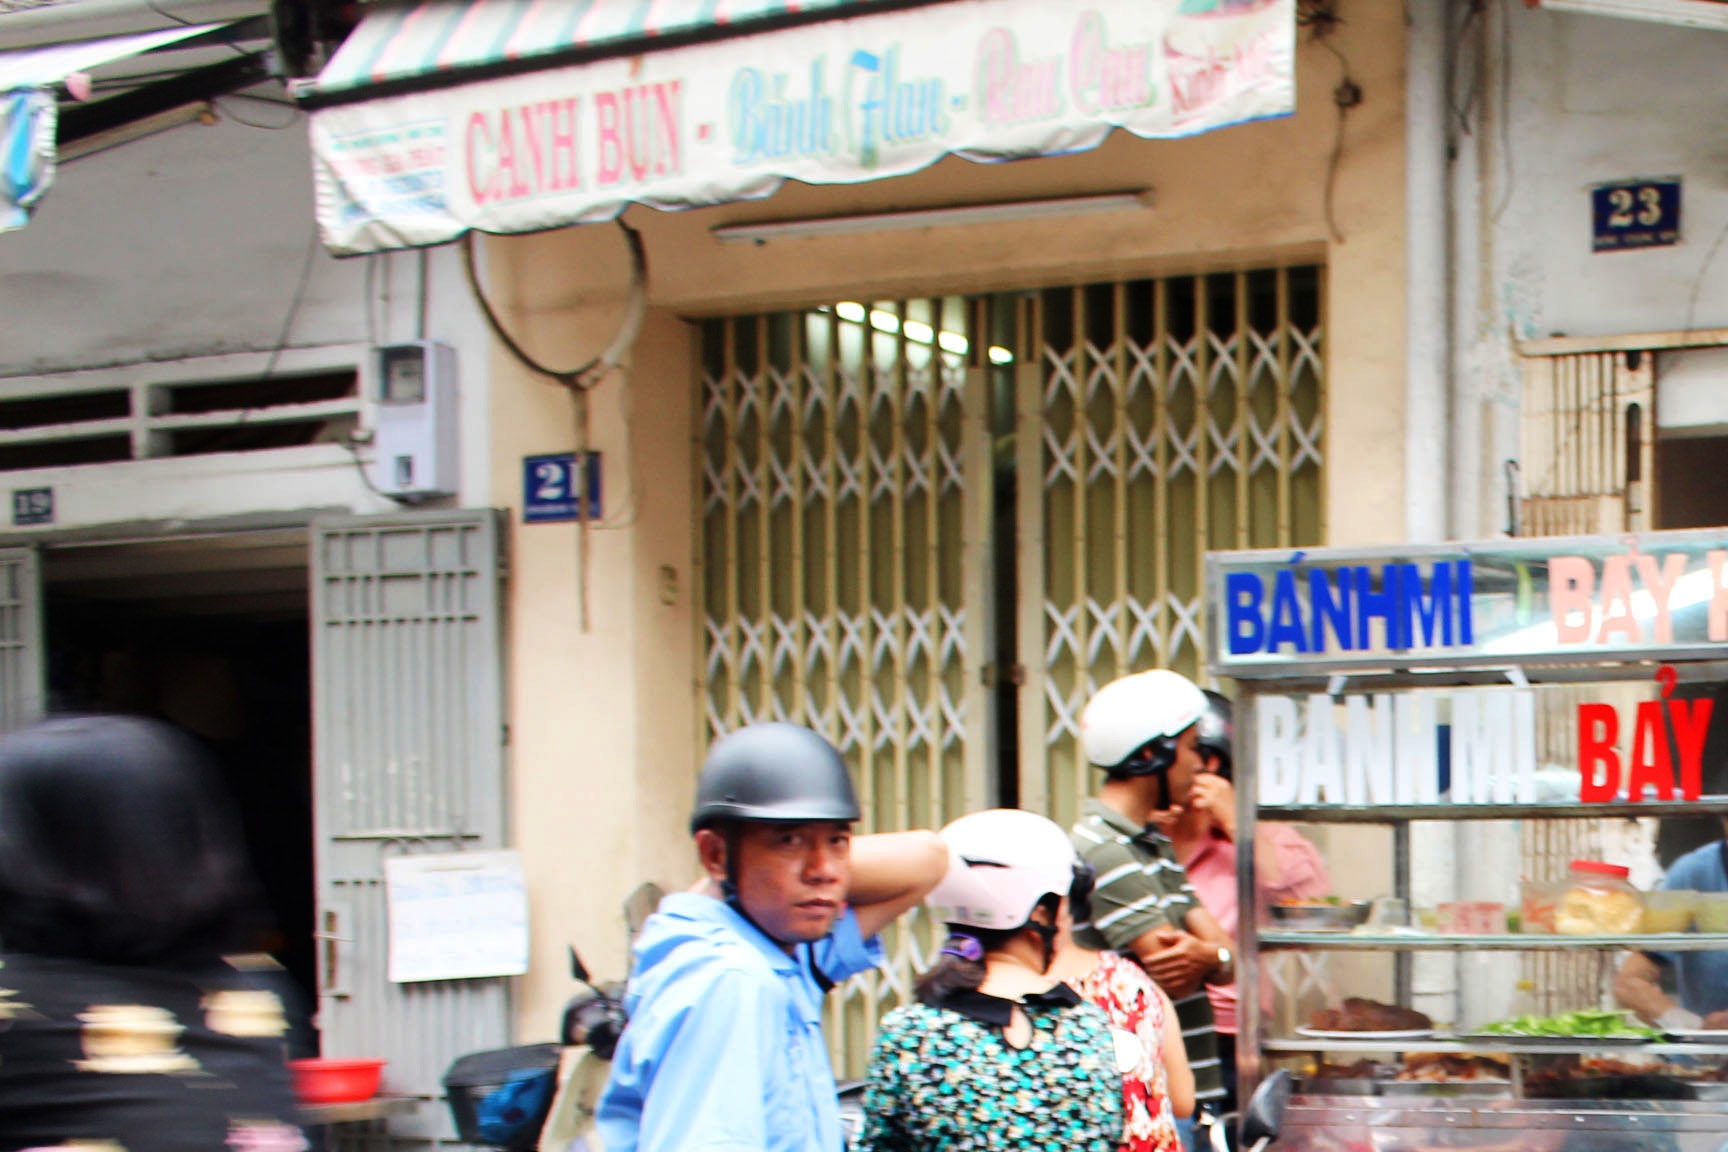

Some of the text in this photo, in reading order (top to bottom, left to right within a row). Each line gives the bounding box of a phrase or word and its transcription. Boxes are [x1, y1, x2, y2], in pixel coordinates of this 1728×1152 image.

[465, 97, 580, 206] CANH
[1608, 186, 1662, 228] 23
[534, 462, 582, 500] 21
[1577, 666, 1714, 803] BẢY
